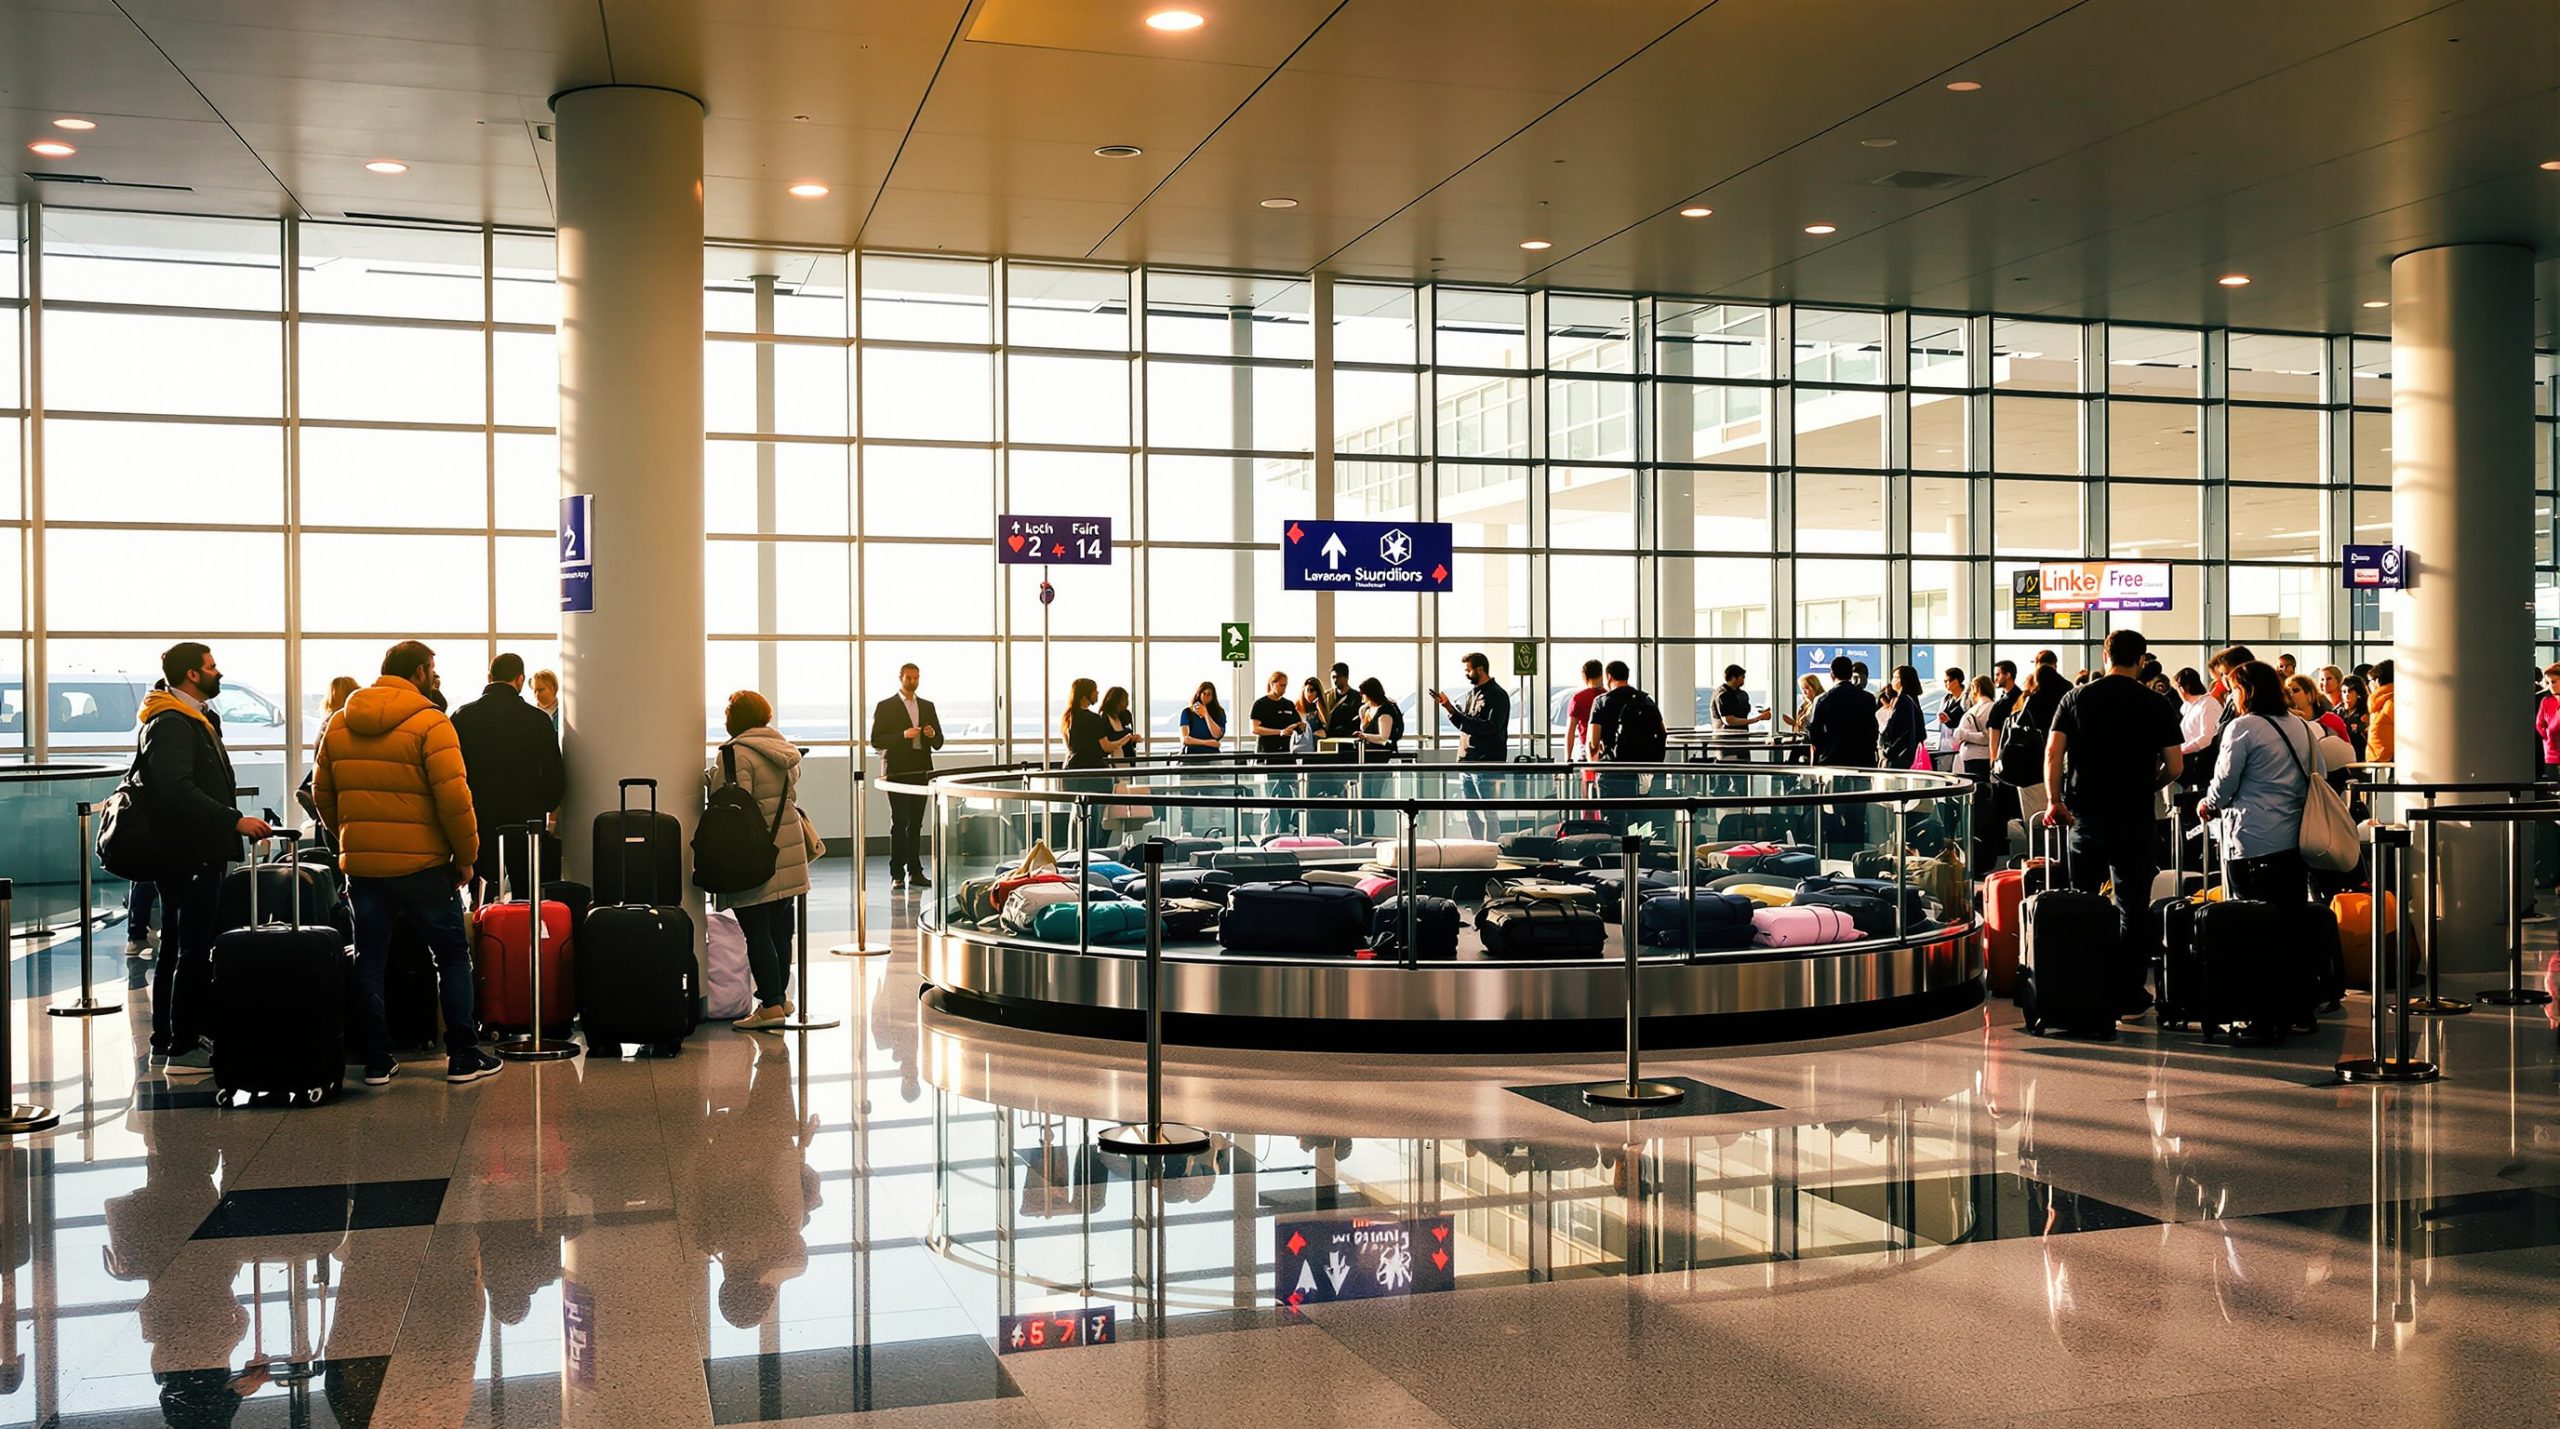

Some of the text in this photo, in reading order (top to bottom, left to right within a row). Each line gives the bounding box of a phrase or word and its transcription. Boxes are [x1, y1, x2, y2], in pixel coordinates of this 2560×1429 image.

[1028, 536, 1102, 559] 2 14
[2110, 570, 2143, 587] Free
